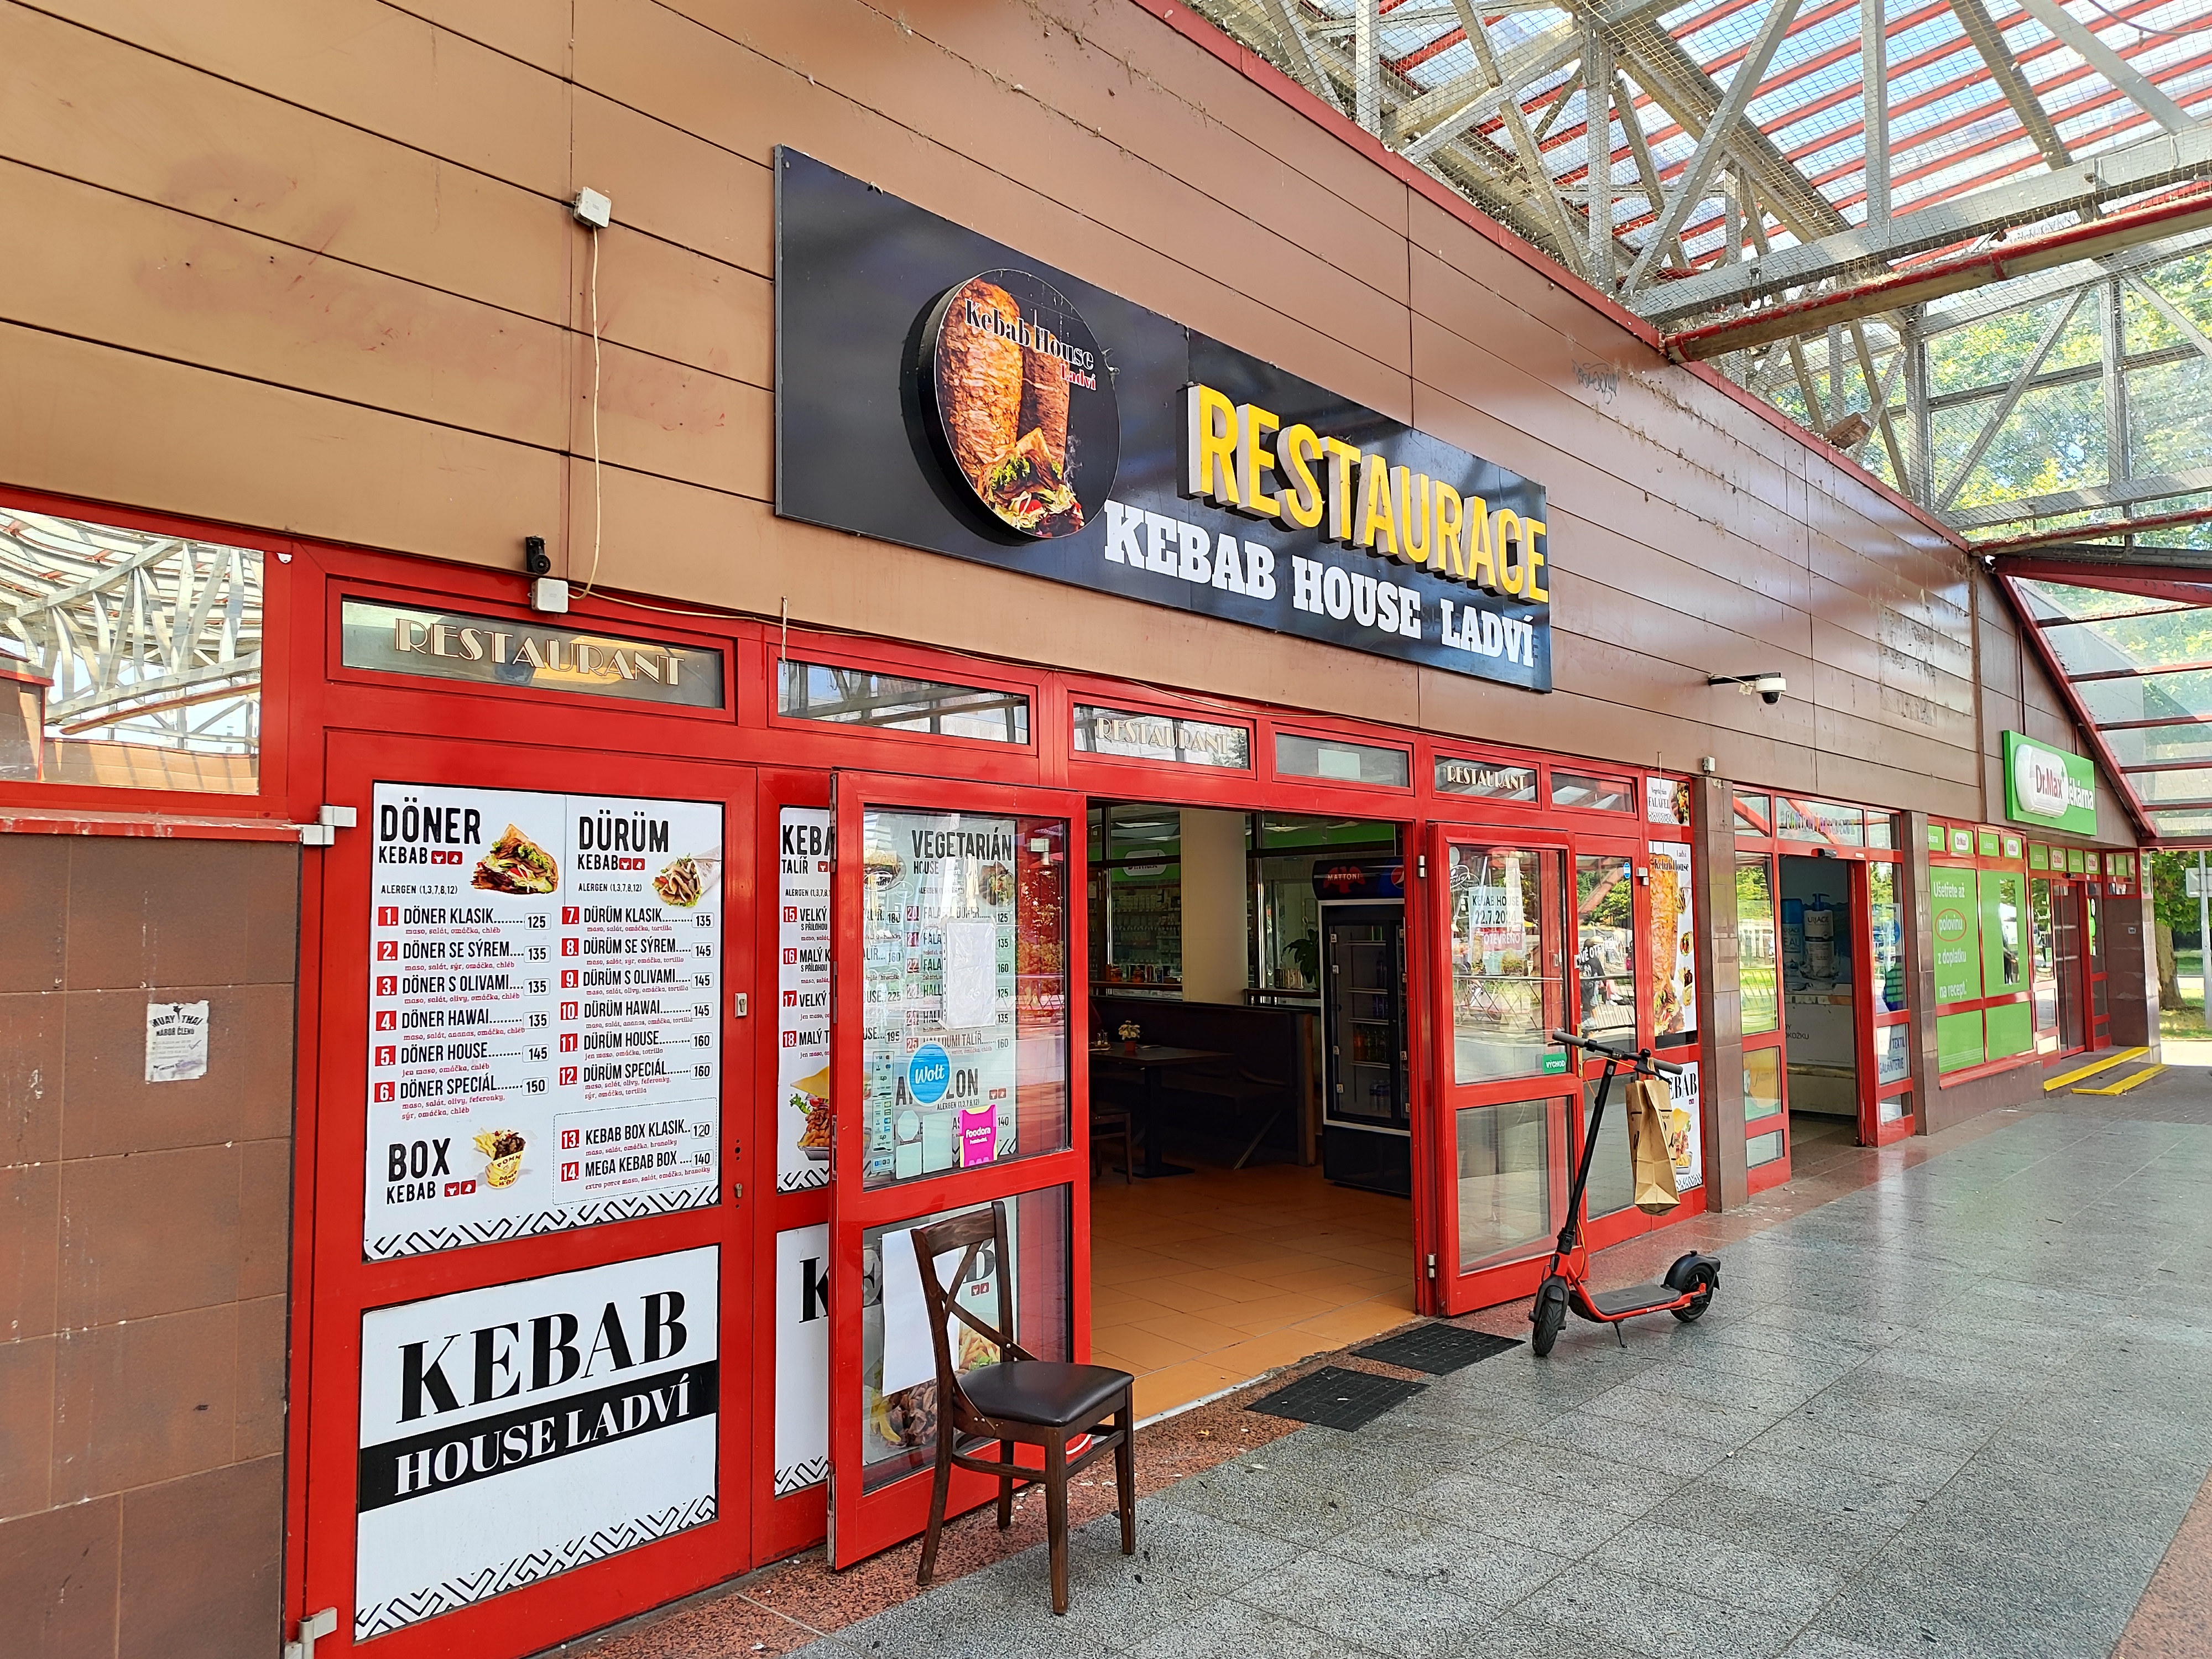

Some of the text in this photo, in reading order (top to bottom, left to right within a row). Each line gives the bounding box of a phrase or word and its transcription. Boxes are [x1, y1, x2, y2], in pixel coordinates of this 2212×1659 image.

[965, 298, 1094, 370] Kebab House
[1060, 363, 1097, 390] Ladví
[1187, 382, 1549, 604] RESTAURACE
[1104, 499, 1534, 667] KEBAB HOUSE LADVÍ
[395, 618, 685, 686] RESTAURANT
[1095, 716, 1229, 755] RESTAURANT
[1446, 765, 1525, 791] RESTAURANT
[2036, 764, 2094, 811] Dr.Max ékárna
[1648, 796, 1670, 809] FALAFEL
[380, 797, 481, 844] DÖNER
[580, 809, 669, 852] DÜRÜM
[912, 827, 1011, 860] VEGETARIÁN
[379, 846, 427, 864] KEBAB
[578, 854, 619, 870] KEBAB
[781, 856, 808, 874] TALÍŘ
[914, 861, 939, 875] HOUSE
[1655, 858, 1689, 872] Kebab House
[1327, 873, 1360, 881] MATTONI
[381, 885, 416, 894] ALERGEN
[578, 883, 608, 892] ALERGEN
[1933, 881, 1965, 898] Ušetřete až
[1496, 895, 1520, 906] HOUSE
[404, 905, 446, 924] DÖNER
[528, 915, 546, 928] 125
[584, 905, 622, 923] DÜRÜM
[696, 915, 711, 927] 135
[800, 905, 827, 922] VELKÝ
[888, 912, 900, 923] 180
[997, 913, 1008, 922] 125
[805, 922, 827, 931] PŘÍLOHOU
[1939, 914, 1963, 935] polovinu
[583, 937, 622, 954] DÜRÜM
[625, 939, 638, 954] SE
[695, 945, 711, 957] 145
[998, 938, 1008, 948] 135
[1484, 931, 1520, 945] OTEVŘENO
[1783, 937, 1801, 947] EAU
[403, 940, 446, 959] DÖNER
[449, 942, 464, 958] SE
[529, 947, 546, 961] 135
[800, 947, 823, 963] MALÝ
[888, 952, 901, 963] 160
[1938, 947, 1966, 967] z doplatku
[805, 963, 828, 972] PŘÍLOHOU
[998, 963, 1009, 973] 160
[403, 974, 445, 994] DÖNER
[448, 976, 456, 992] S
[528, 980, 546, 993] 135
[583, 968, 622, 987] DÜRÜM
[624, 971, 631, 985] S
[695, 975, 710, 986] 145
[799, 990, 826, 1007] VELKÝ
[888, 992, 901, 1001] 225
[998, 988, 1008, 998] 125
[1939, 985, 1947, 998] na
[584, 1000, 623, 1018] DÜRÜM
[694, 1005, 709, 1017] 145
[998, 1013, 1008, 1023] 135
[152, 1015, 204, 1028] MUAY THAI
[402, 1009, 444, 1029] DÖNER
[529, 1014, 547, 1027] 135
[584, 1031, 622, 1050] DÜRÜM
[694, 1035, 710, 1047] 160
[799, 1028, 822, 1046] MALÝ
[887, 1031, 900, 1042] 195
[998, 1039, 1009, 1048] 160
[1892, 1036, 1905, 1050] TEXTIL
[401, 1044, 444, 1064] DÖNER
[529, 1047, 547, 1060] 145
[583, 1063, 622, 1082] DÜRÜM
[694, 1066, 710, 1077] 160
[1546, 1060, 1566, 1068] VÝCHOD
[915, 1064, 945, 1084] Wolt
[400, 1079, 443, 1099] DÖNER
[526, 1079, 545, 1093] 150
[1669, 1072, 1697, 1100] EBAB
[937, 1102, 957, 1110] ALERGEN
[998, 1117, 1009, 1126] 140
[586, 1126, 621, 1145] KEBAB
[625, 1123, 646, 1140] BOX
[693, 1124, 710, 1138] 120
[966, 1126, 991, 1138] foodora
[388, 1138, 451, 1182] BOX
[585, 1159, 616, 1177] MEGA
[619, 1154, 654, 1172] KEBAB
[657, 1151, 677, 1167] BOX
[695, 1152, 710, 1166] 140
[387, 1181, 436, 1205] KEBAB
[395, 1291, 687, 1424] KEBAB
[394, 1373, 690, 1496] HOUSE LADVÍ
